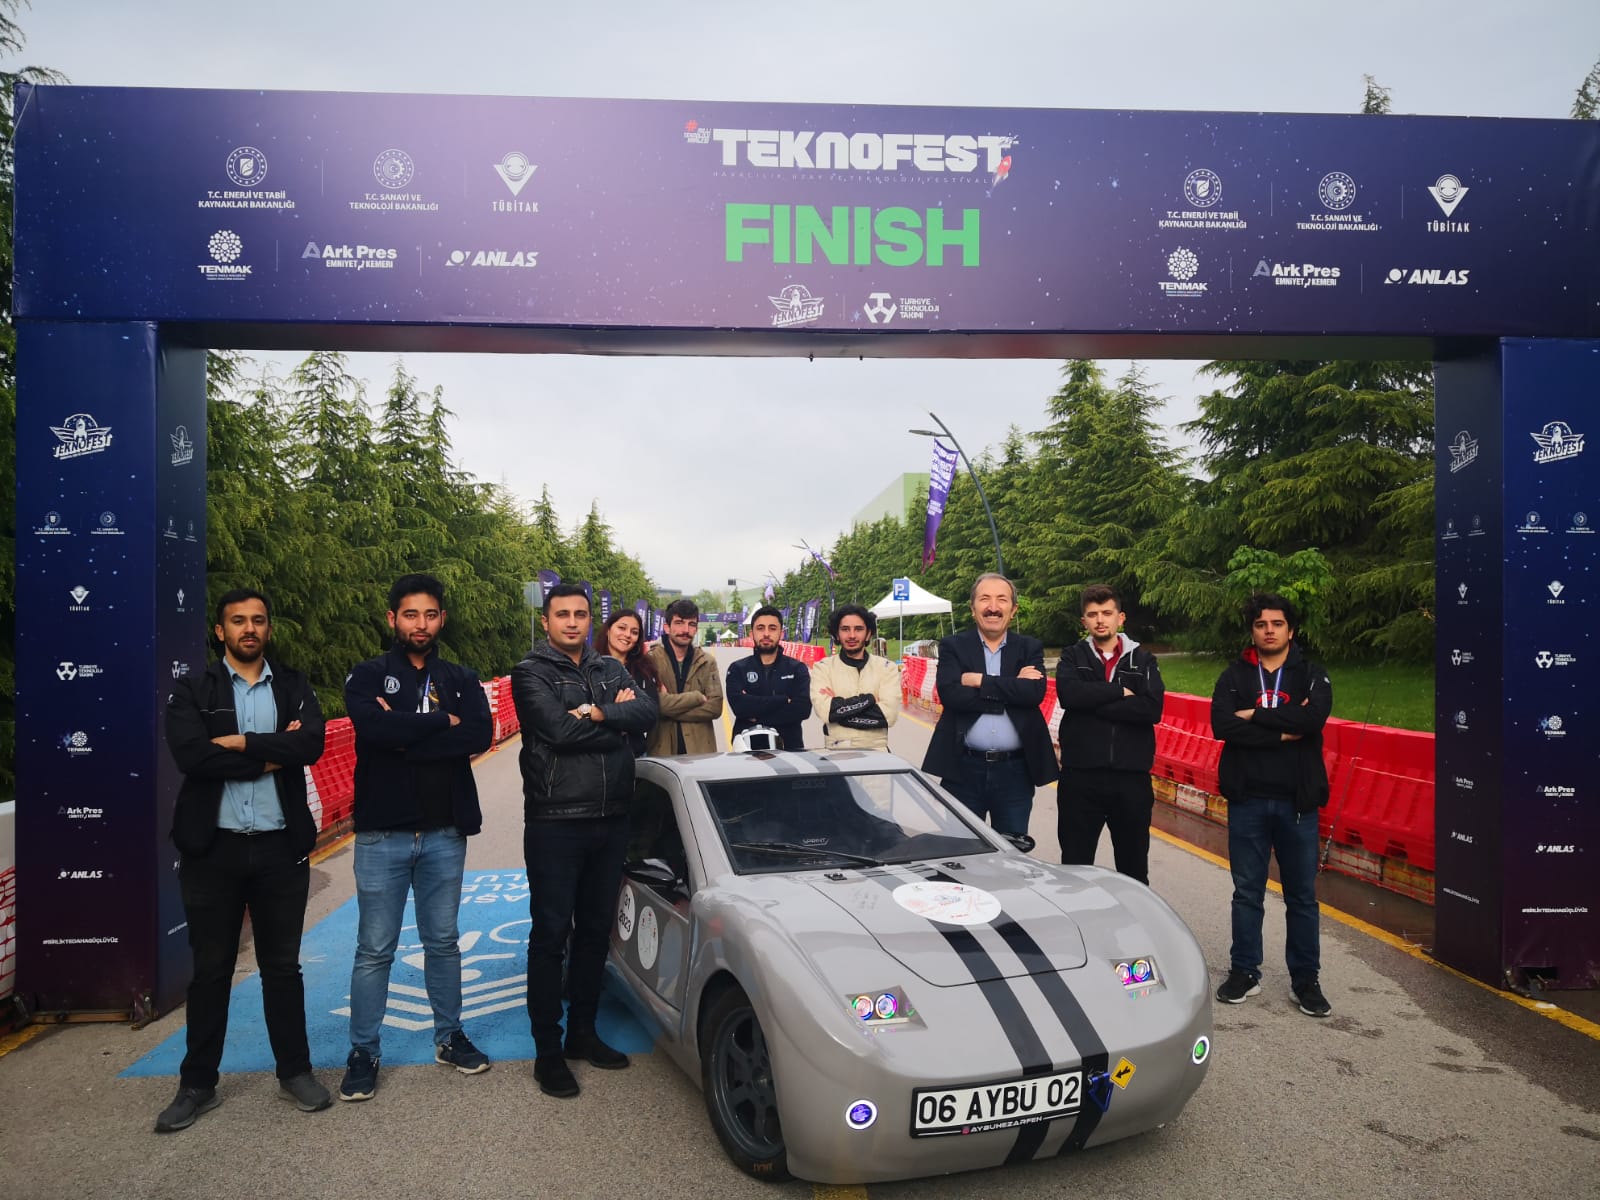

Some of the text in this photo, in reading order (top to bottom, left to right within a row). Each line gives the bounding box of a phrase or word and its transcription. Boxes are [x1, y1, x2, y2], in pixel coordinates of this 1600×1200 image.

[713, 128, 1011, 172] TEKNOFEST
[208, 191, 222, 199] T.C.
[224, 190, 251, 199] ENERJİ
[252, 191, 263, 199] VE
[365, 193, 379, 201] T.C.
[380, 192, 409, 201] SANAYİ
[198, 199, 295, 209] KAYNAKLAR BAKANLIĞI
[349, 201, 393, 210] TEKNOLOJİ
[492, 200, 539, 213] TÜBİTAK
[1167, 211, 1181, 219] T.C.
[1182, 210, 1207, 219] ENERJİ
[1324, 213, 1351, 222] SANAYİ
[1158, 219, 1247, 229] KAYNAKLAR BAKANLIĞI
[1296, 222, 1337, 230] TEKNOLOJİ
[1427, 221, 1470, 233] TÜBİTAK
[725, 203, 980, 267] FINISH
[322, 244, 398, 260] Ark Pres
[472, 251, 539, 268] ANLAS
[198, 265, 252, 274] TENMAK
[1271, 263, 1341, 278] Ark Pres
[1408, 269, 1470, 285] ANLAS
[1158, 282, 1208, 291] TENMAK
[770, 303, 825, 325] TEKNOFEST
[53, 434, 113, 458] TEKNOFEST
[1533, 440, 1585, 462] TEKNOFEST
[894, 583, 905, 596] P
[1546, 845, 1575, 853] ANLAS
[70, 871, 103, 879] ANLAS
[918, 1076, 1079, 1124] 06 AYBÜ 02
